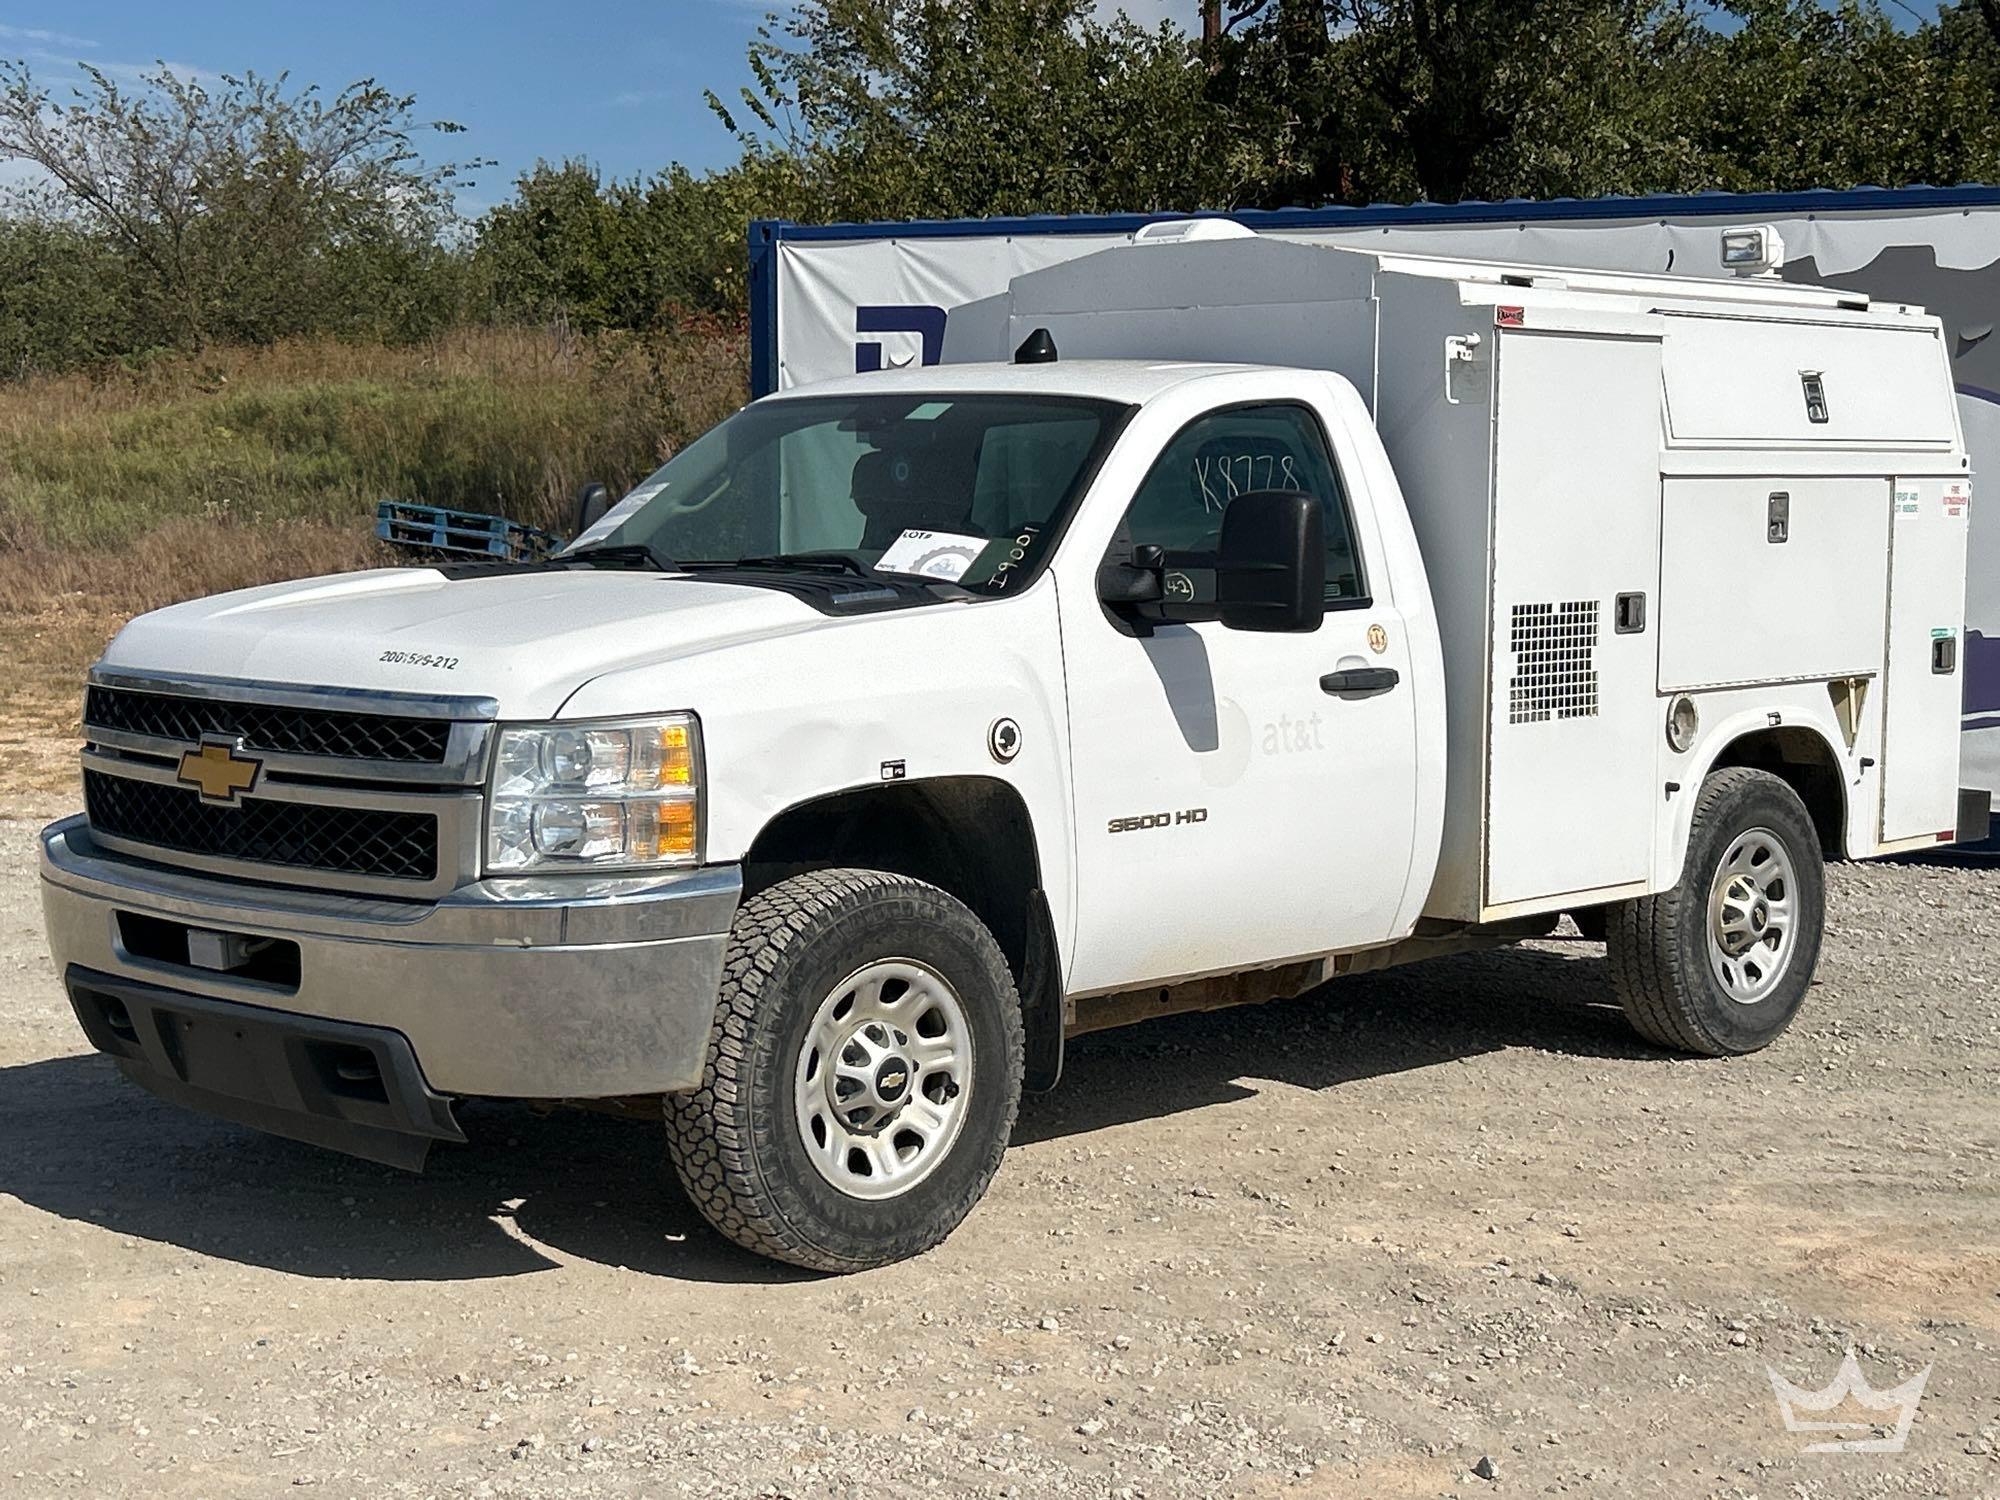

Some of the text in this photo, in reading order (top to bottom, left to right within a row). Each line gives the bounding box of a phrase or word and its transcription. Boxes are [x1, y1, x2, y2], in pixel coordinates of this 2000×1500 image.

[1195, 456, 1300, 513] K8778
[1262, 711, 1325, 756] at&t
[1107, 807, 1208, 834] 3500 HD
